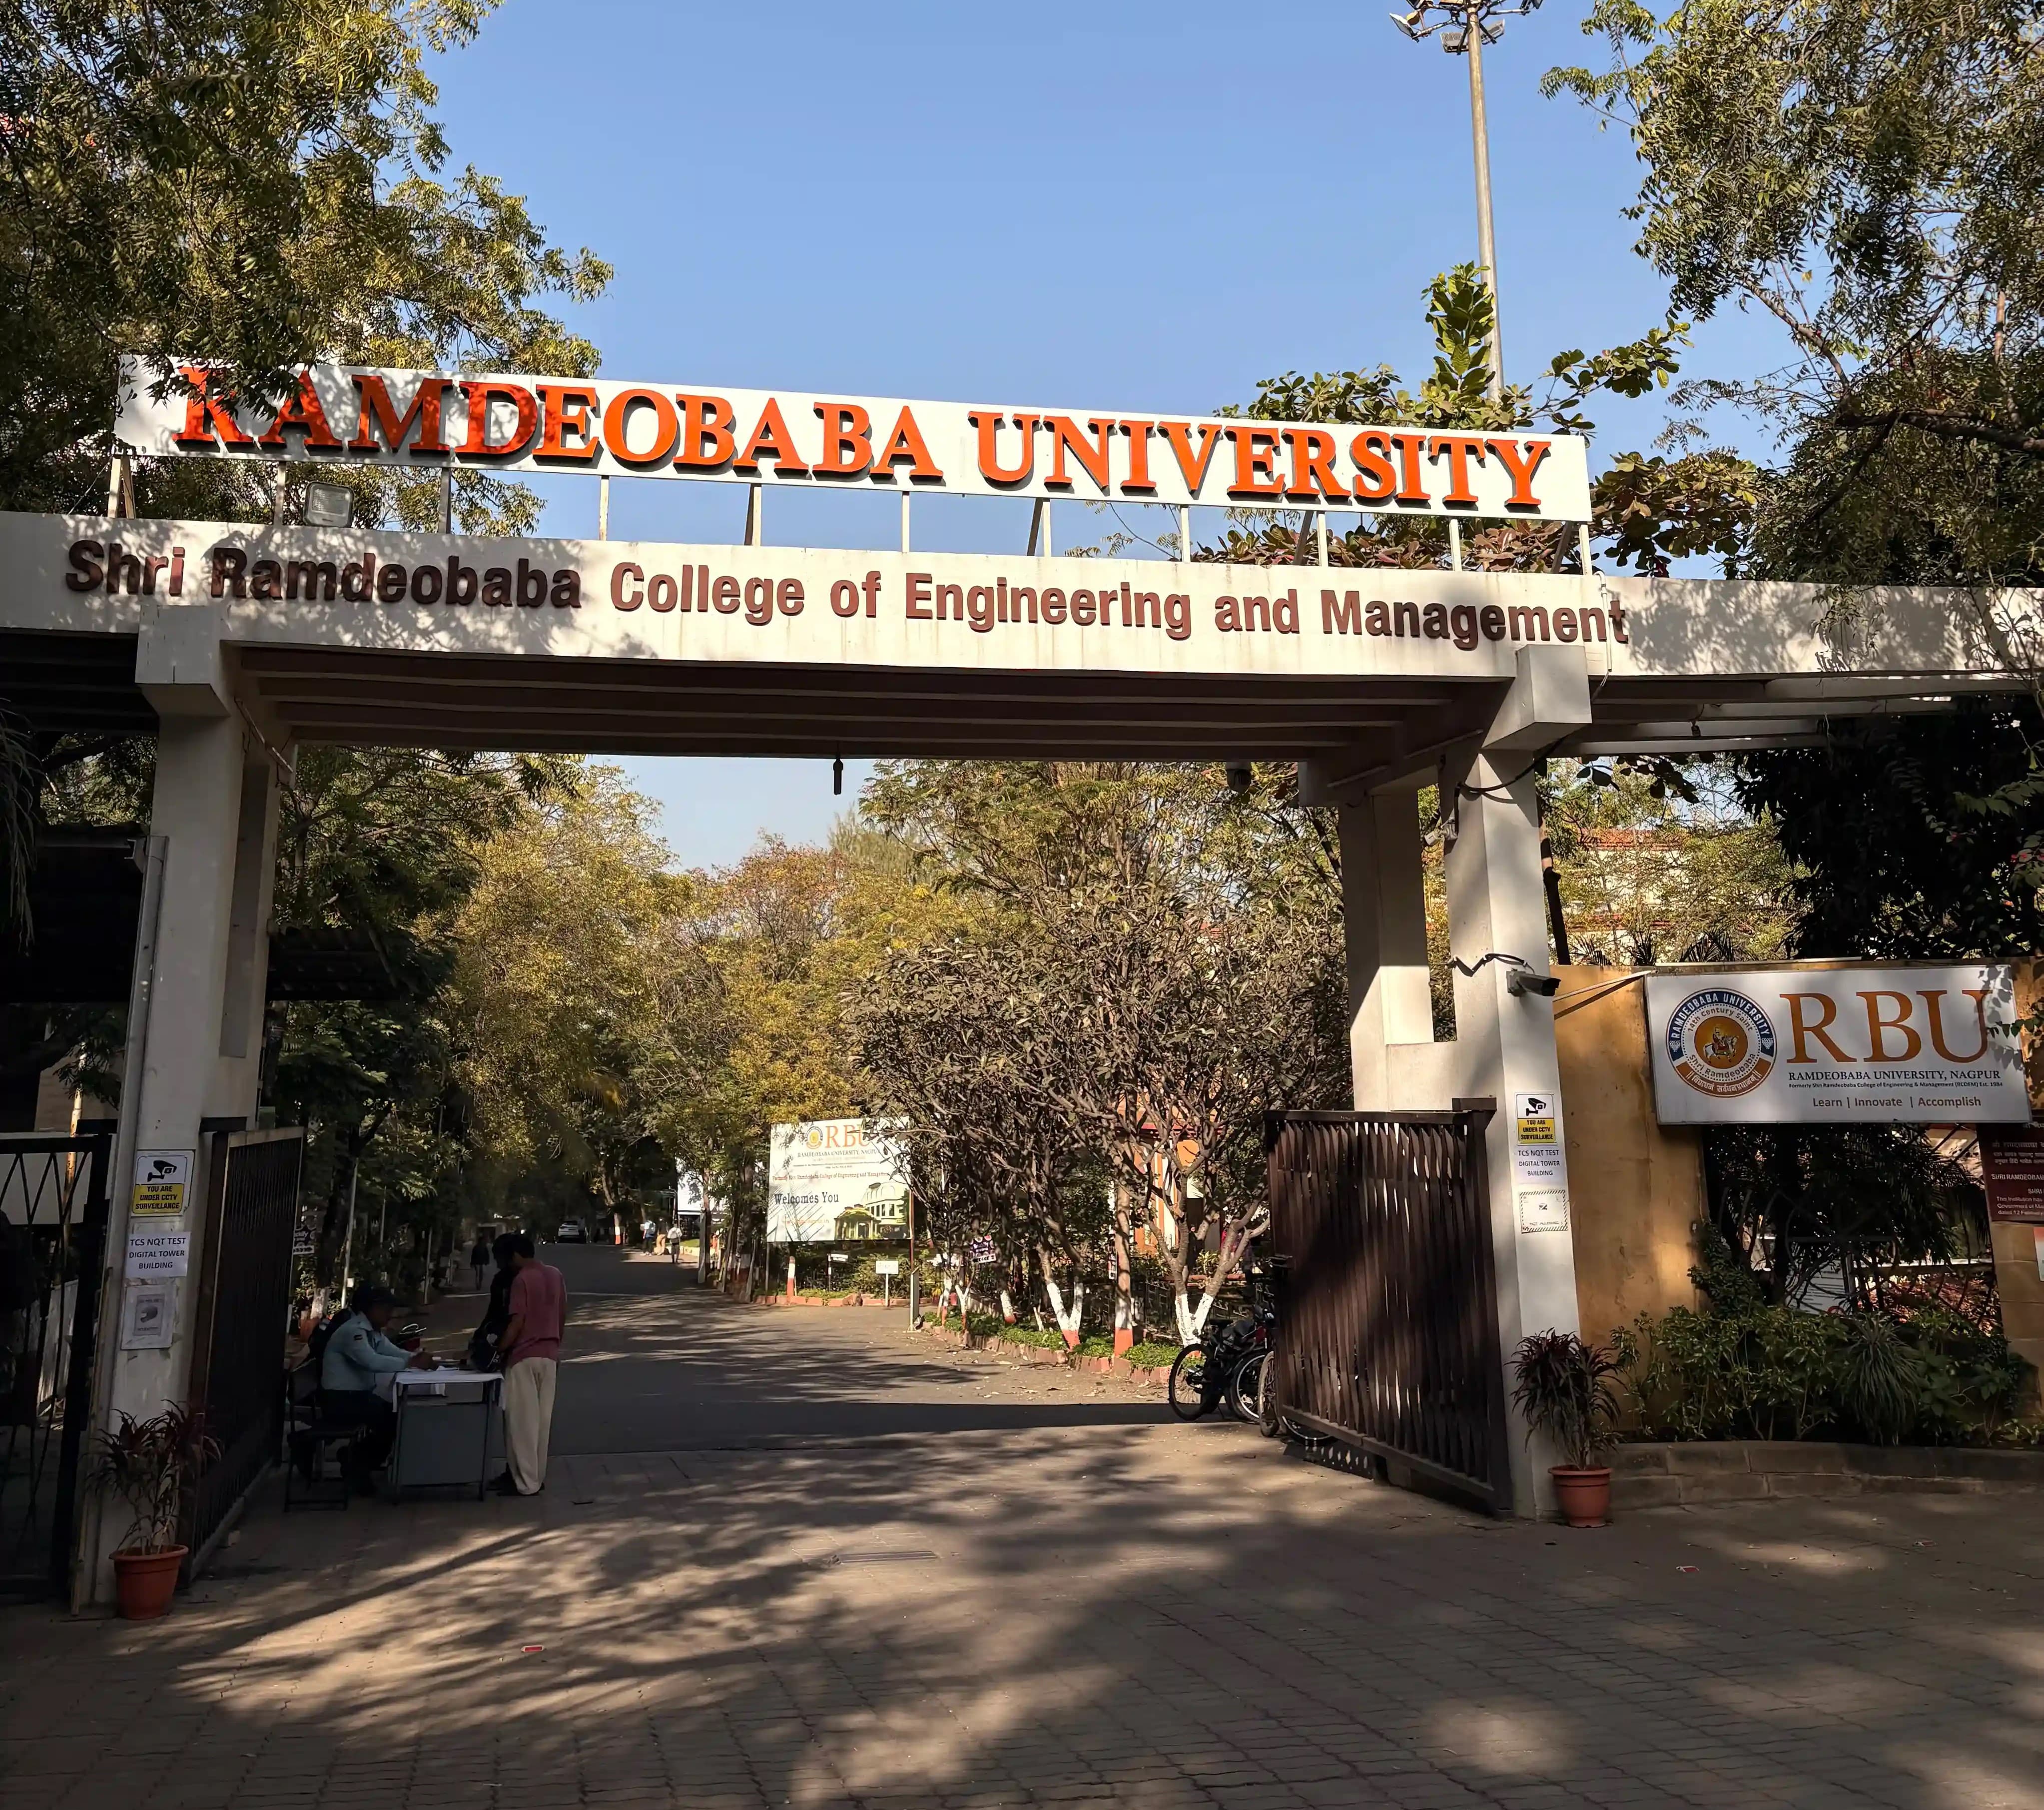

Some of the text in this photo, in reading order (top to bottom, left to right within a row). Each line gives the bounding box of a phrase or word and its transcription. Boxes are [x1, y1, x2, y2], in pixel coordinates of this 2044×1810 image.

[172, 366, 1551, 505] RAMDEOBABA UNIVERSITY
[65, 539, 1629, 651] Shri Ramdeobaba College of Engineering and Management
[1671, 993, 1770, 1038] RAMDEOBABA UNIVERSITY
[1688, 1015, 1701, 1032] 14th
[1779, 989, 1994, 1064] RBU
[1689, 1053, 1756, 1079] Shri Ramdeobaba
[1789, 1070, 2001, 1081] RAMDEOBABA UNIVERSITY, NAGPUR
[1813, 1098, 1843, 1107] Learn
[1854, 1097, 1903, 1106] Innovate
[1918, 1096, 1982, 1108] Accomplish
[774, 1191, 839, 1204] Welcomes You
